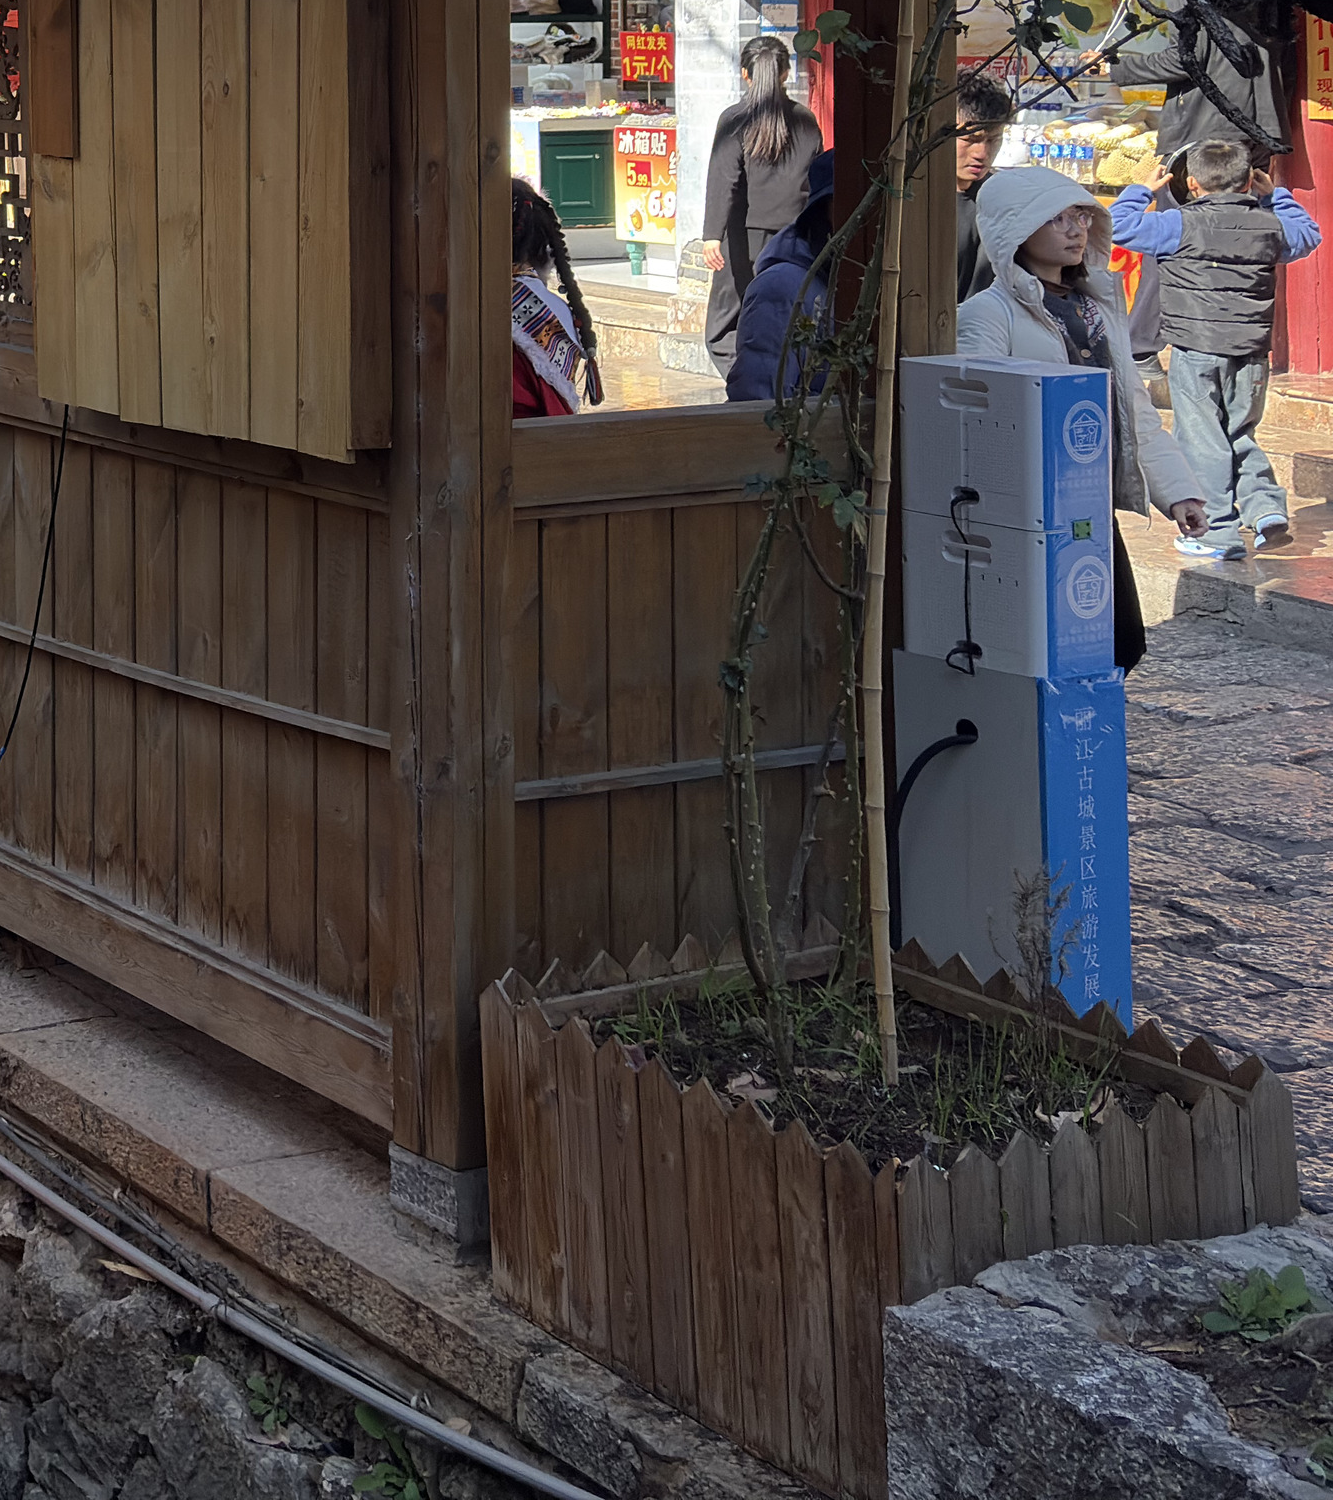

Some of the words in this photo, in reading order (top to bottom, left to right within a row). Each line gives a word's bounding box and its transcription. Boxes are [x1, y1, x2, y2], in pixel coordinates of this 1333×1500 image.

[625, 35, 668, 50] 网红发夹
[1313, 18, 1333, 41] 1
[622, 55, 673, 81] 1元/个
[618, 130, 667, 156] 冰箱贴
[1074, 706, 1102, 1012] 丽江古城景区旅游发展
